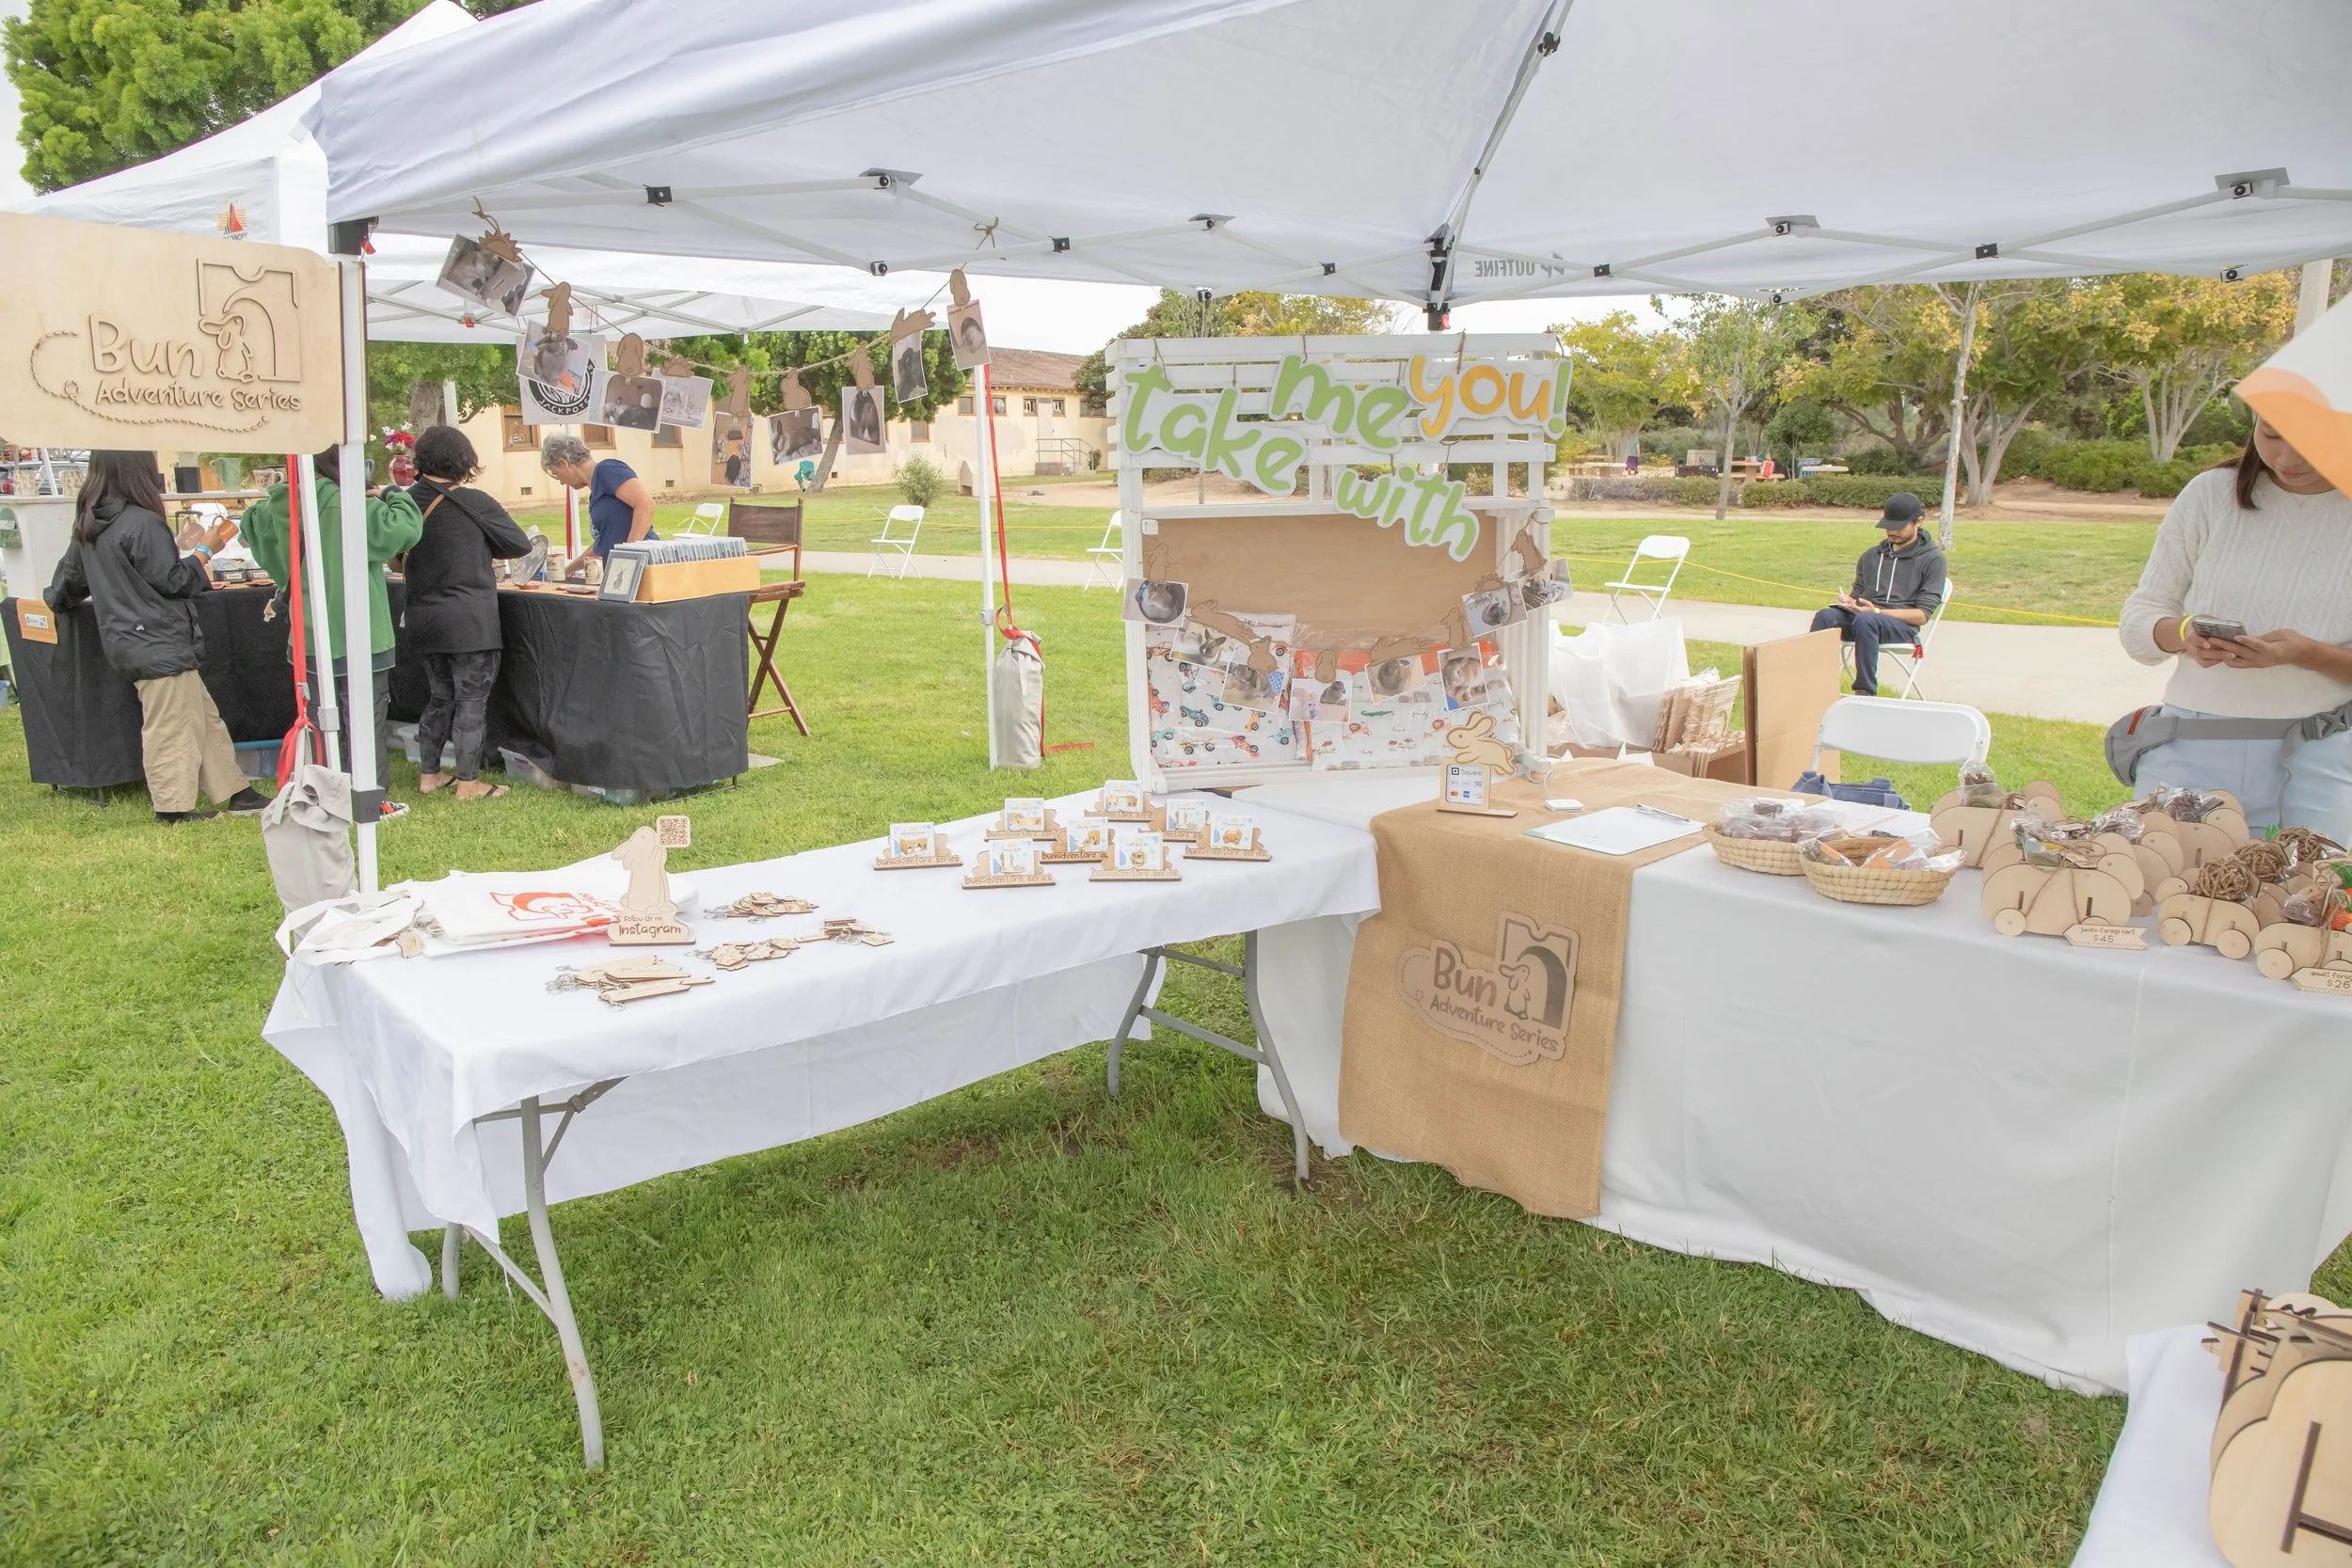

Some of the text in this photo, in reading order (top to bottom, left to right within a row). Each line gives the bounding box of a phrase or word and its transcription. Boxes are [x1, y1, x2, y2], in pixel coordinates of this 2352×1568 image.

[88, 312, 203, 378] Bun
[96, 377, 301, 411] Adventure Series
[1124, 355, 1572, 557] take me with you!
[1460, 768, 1483, 777] Square
[618, 923, 681, 938] Instagram
[2093, 934, 2114, 943] $45
[1433, 945, 1498, 1007] Bun
[2327, 979, 2351, 990] $26
[2332, 971, 2352, 981] forag
[1430, 994, 1559, 1053] Adventure Series
